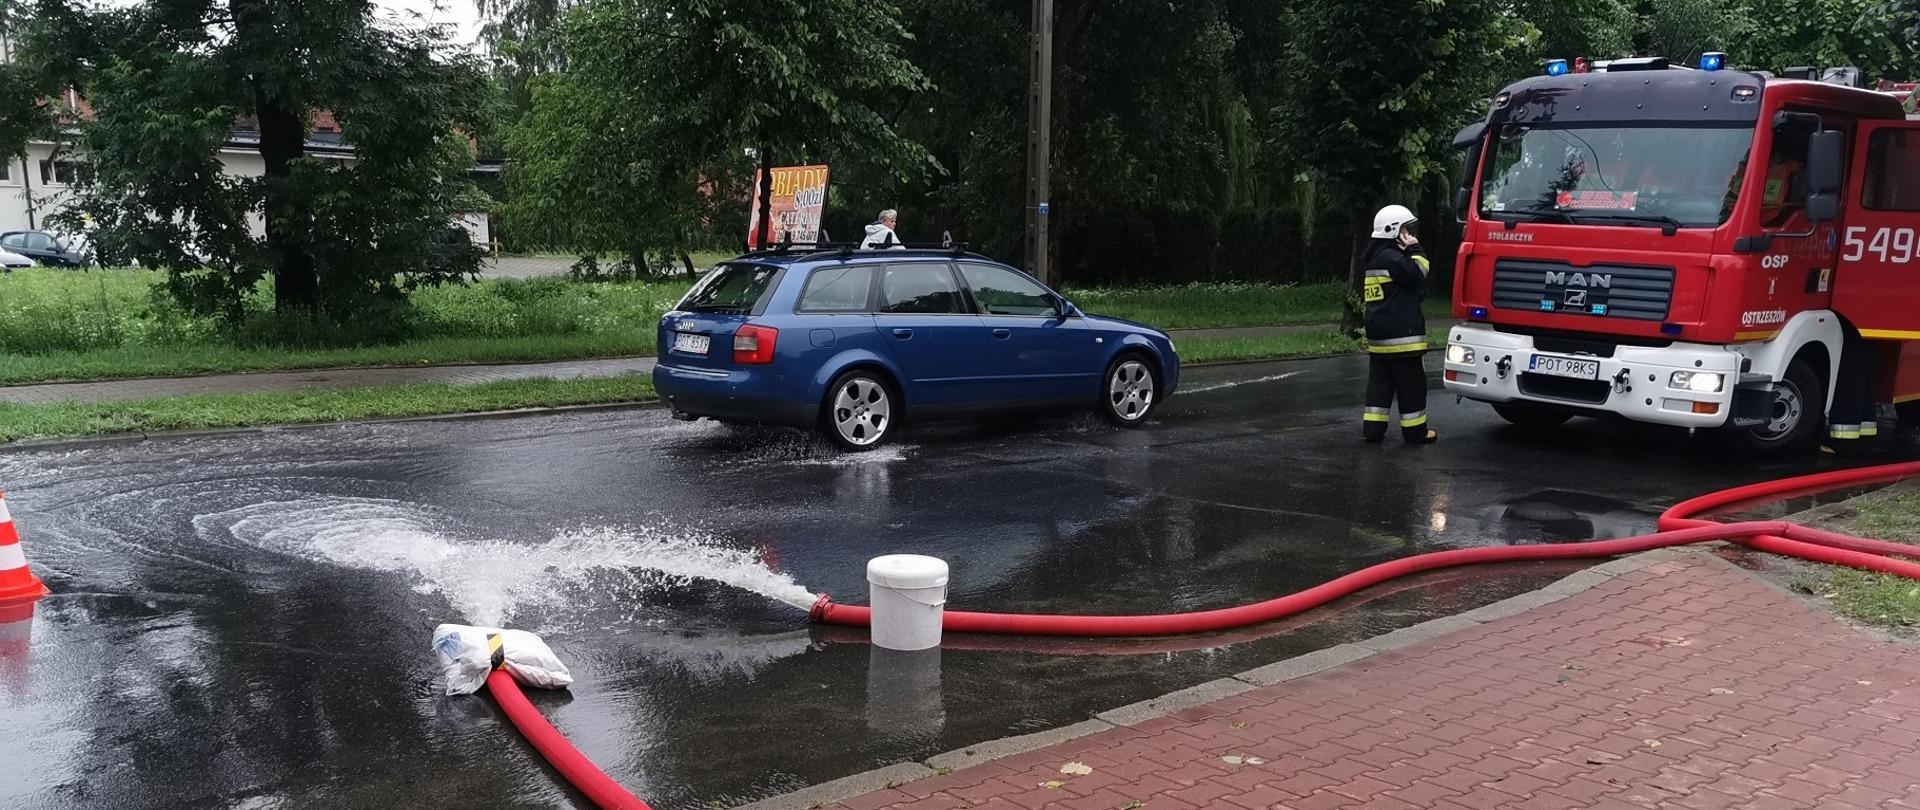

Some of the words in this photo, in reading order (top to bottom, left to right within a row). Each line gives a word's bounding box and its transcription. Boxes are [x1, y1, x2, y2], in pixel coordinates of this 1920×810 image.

[1488, 232, 1534, 241] STOLARCZYK
[1843, 226, 1920, 263] 549
[1761, 255, 1789, 268] OSP
[1545, 271, 1612, 288] MAN
[1742, 307, 1787, 324] OSTRZESZÓW
[678, 334, 690, 347] POT
[1537, 357, 1562, 371] POT
[1566, 360, 1595, 375] 98KS
